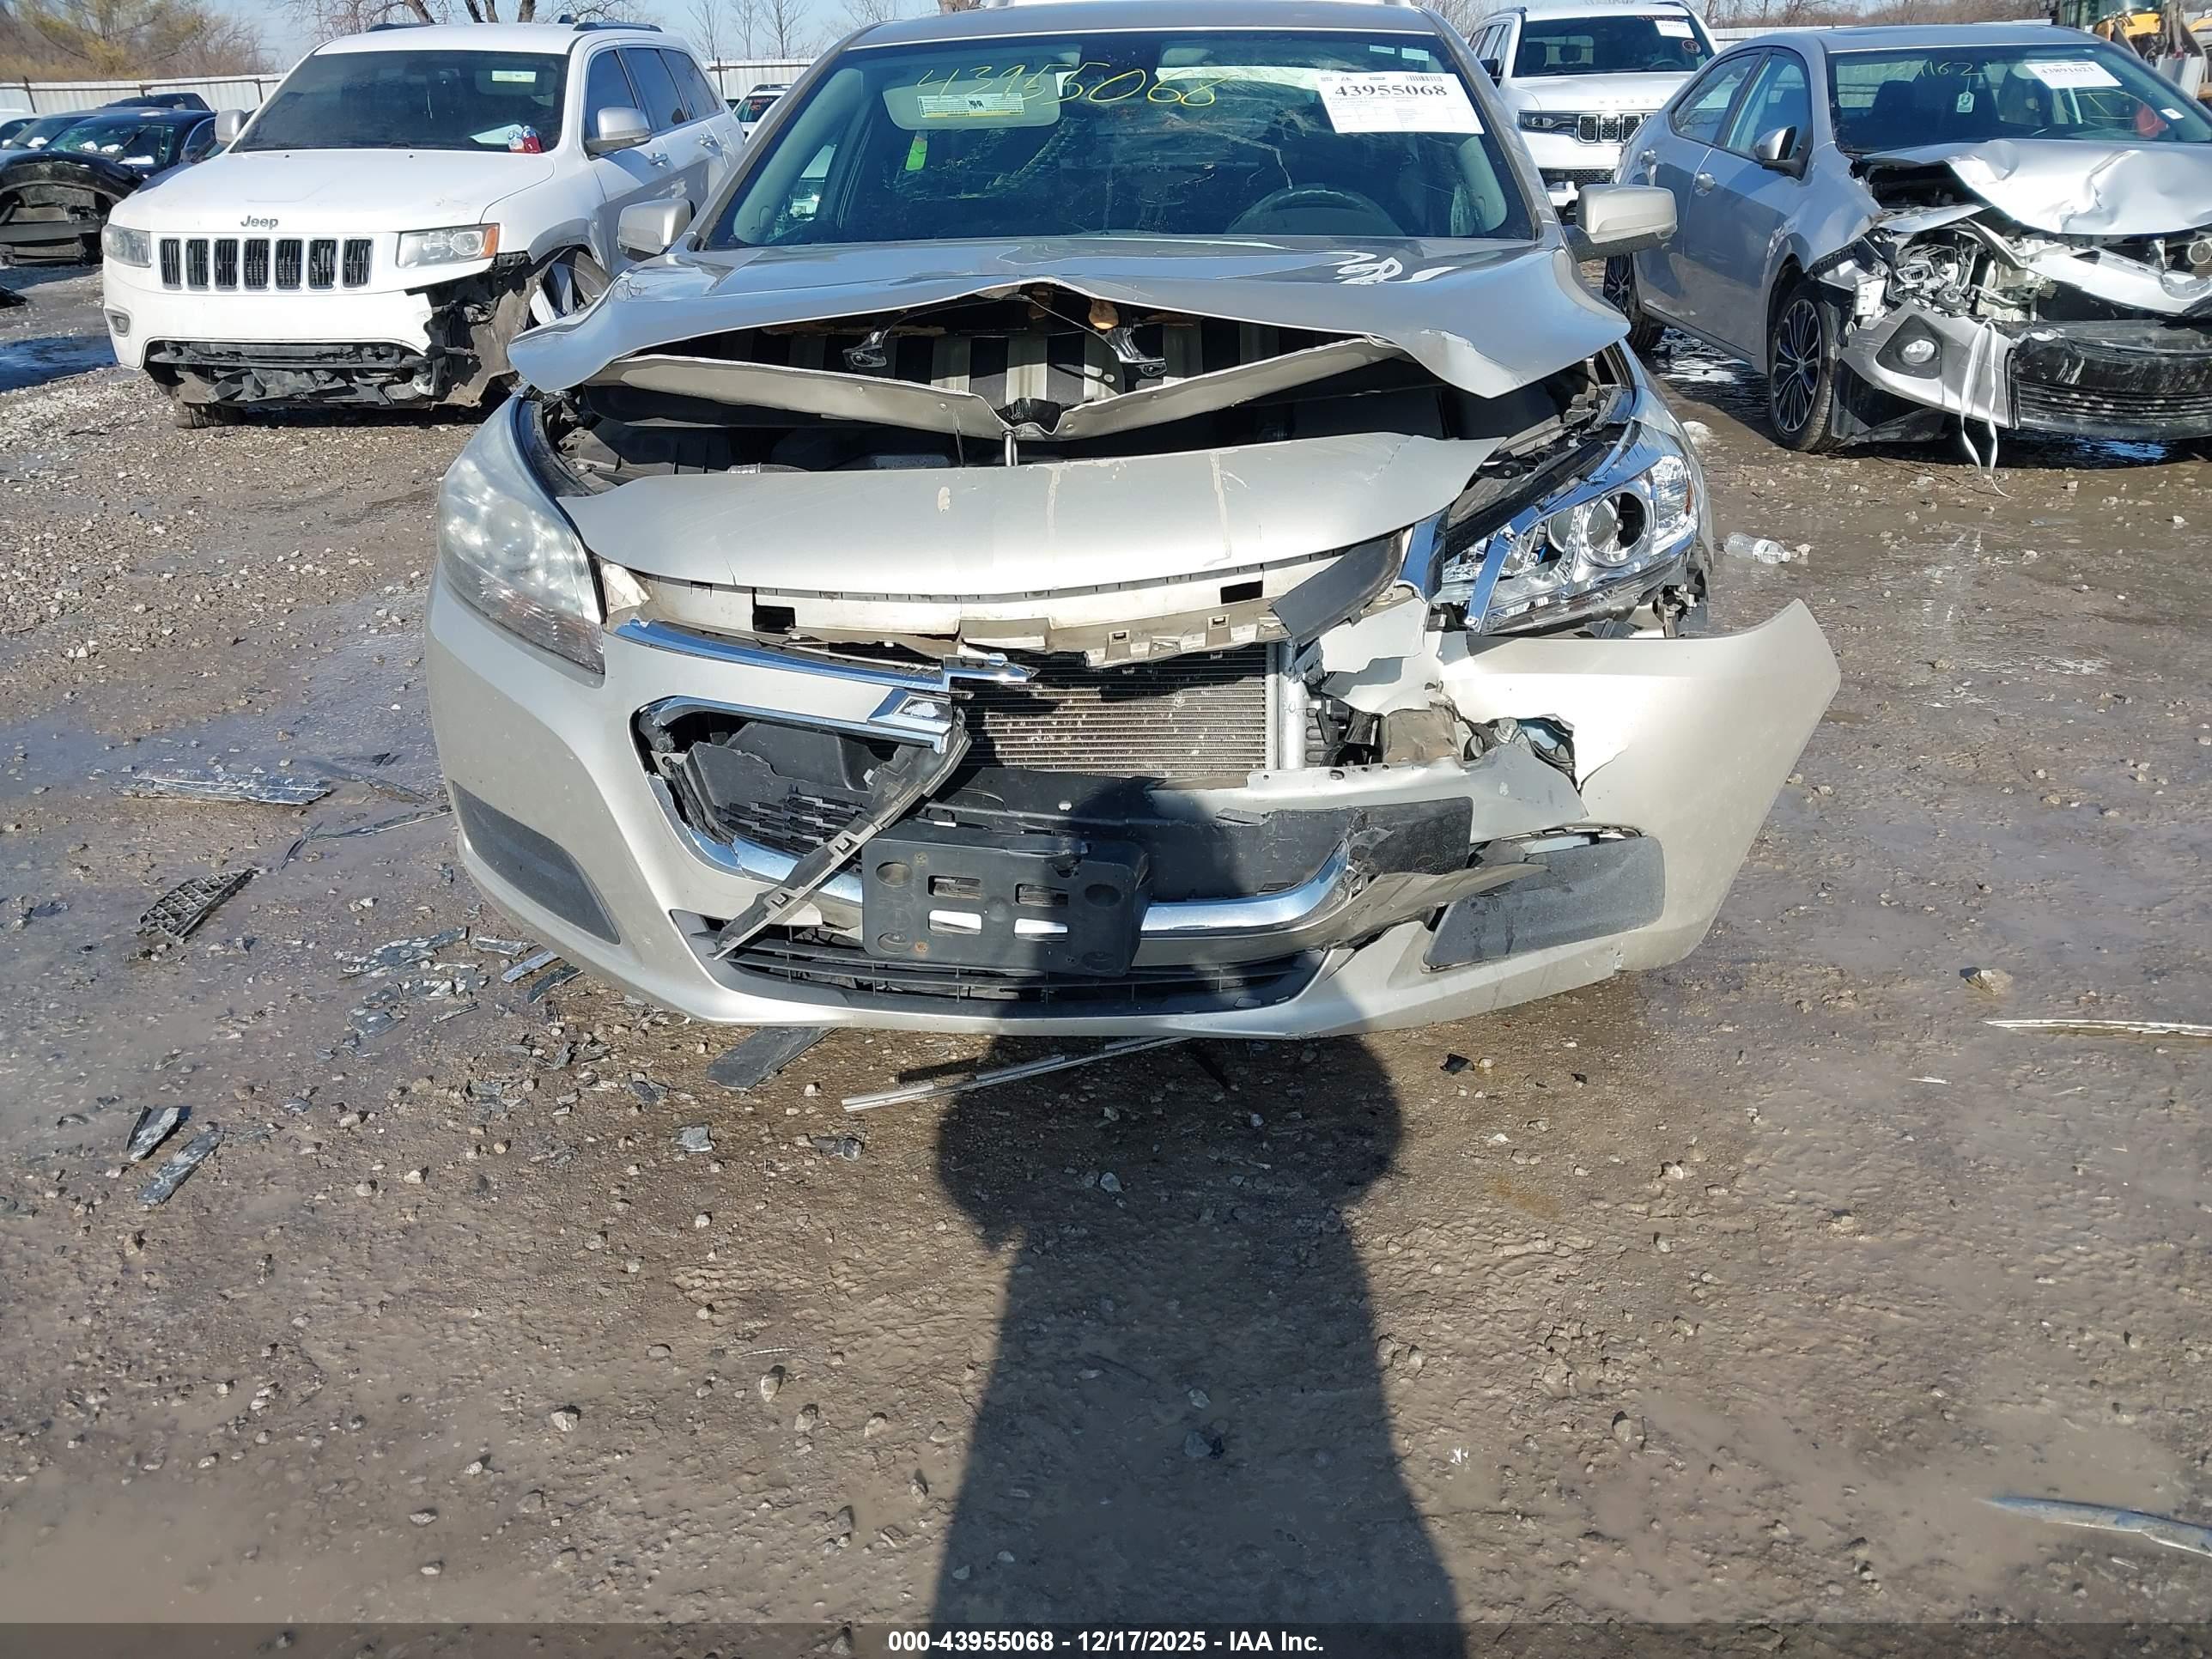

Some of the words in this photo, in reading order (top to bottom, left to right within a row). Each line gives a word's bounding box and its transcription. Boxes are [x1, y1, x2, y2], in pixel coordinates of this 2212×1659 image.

[917, 61, 1239, 106] 43955068
[1334, 84, 1448, 97] 43955068
[240, 215, 279, 230] Jeep
